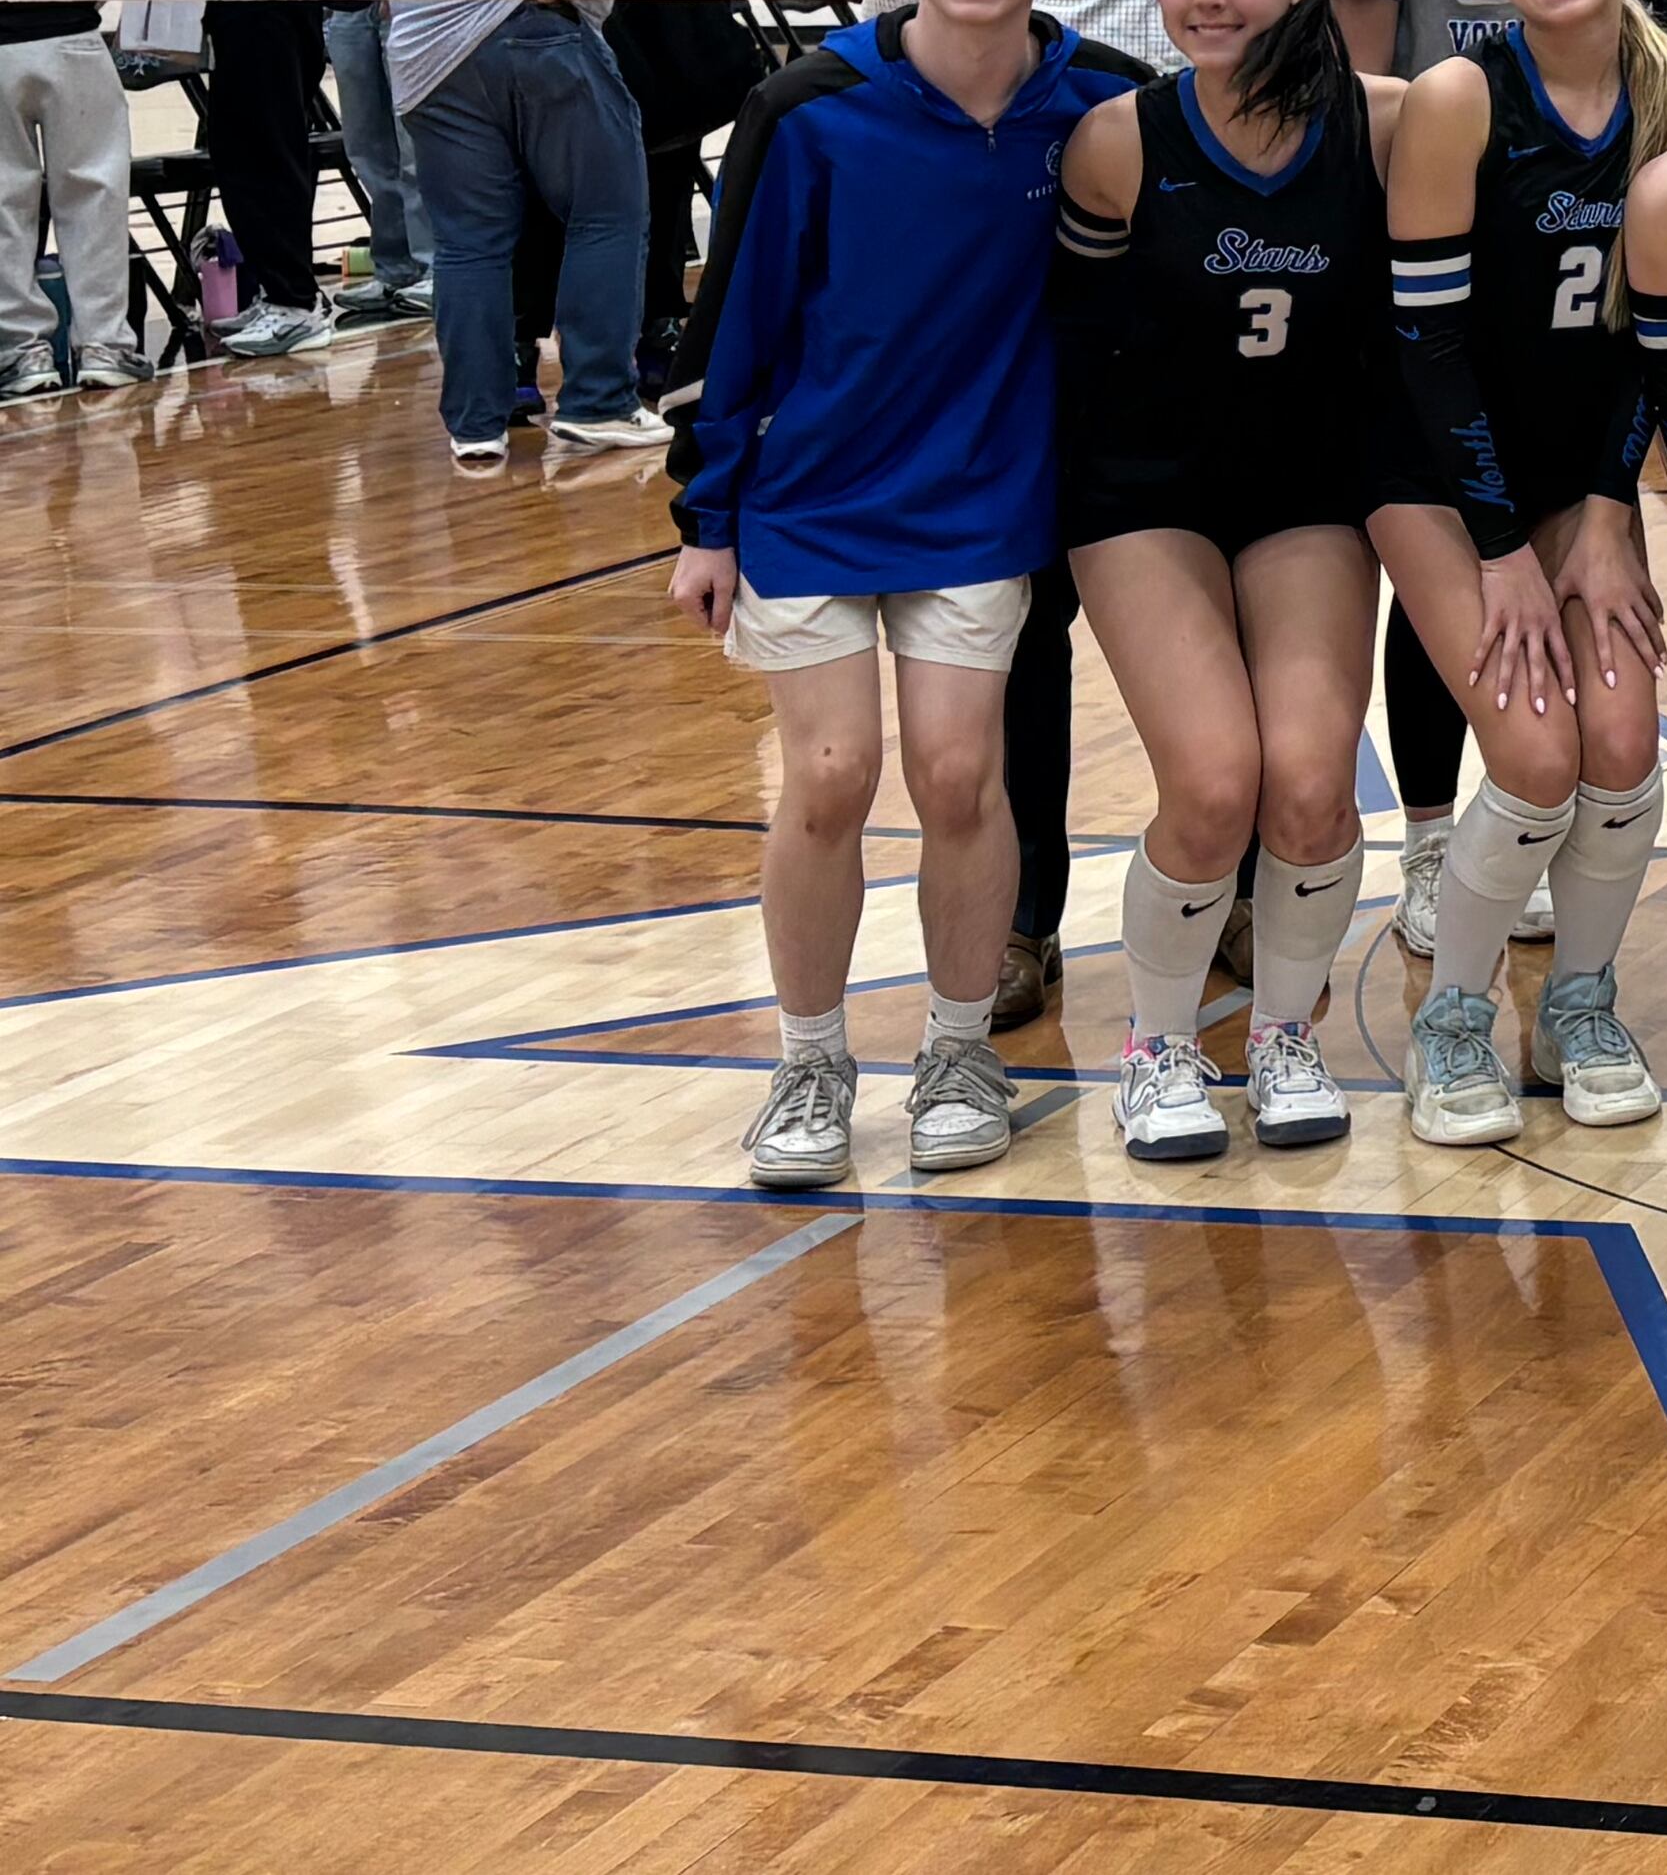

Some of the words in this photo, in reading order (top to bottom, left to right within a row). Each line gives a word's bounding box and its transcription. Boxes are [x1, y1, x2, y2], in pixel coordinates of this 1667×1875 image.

[1204, 228, 1330, 275] Stars
[1551, 246, 1603, 329] 2
[1237, 288, 1293, 358] 3
